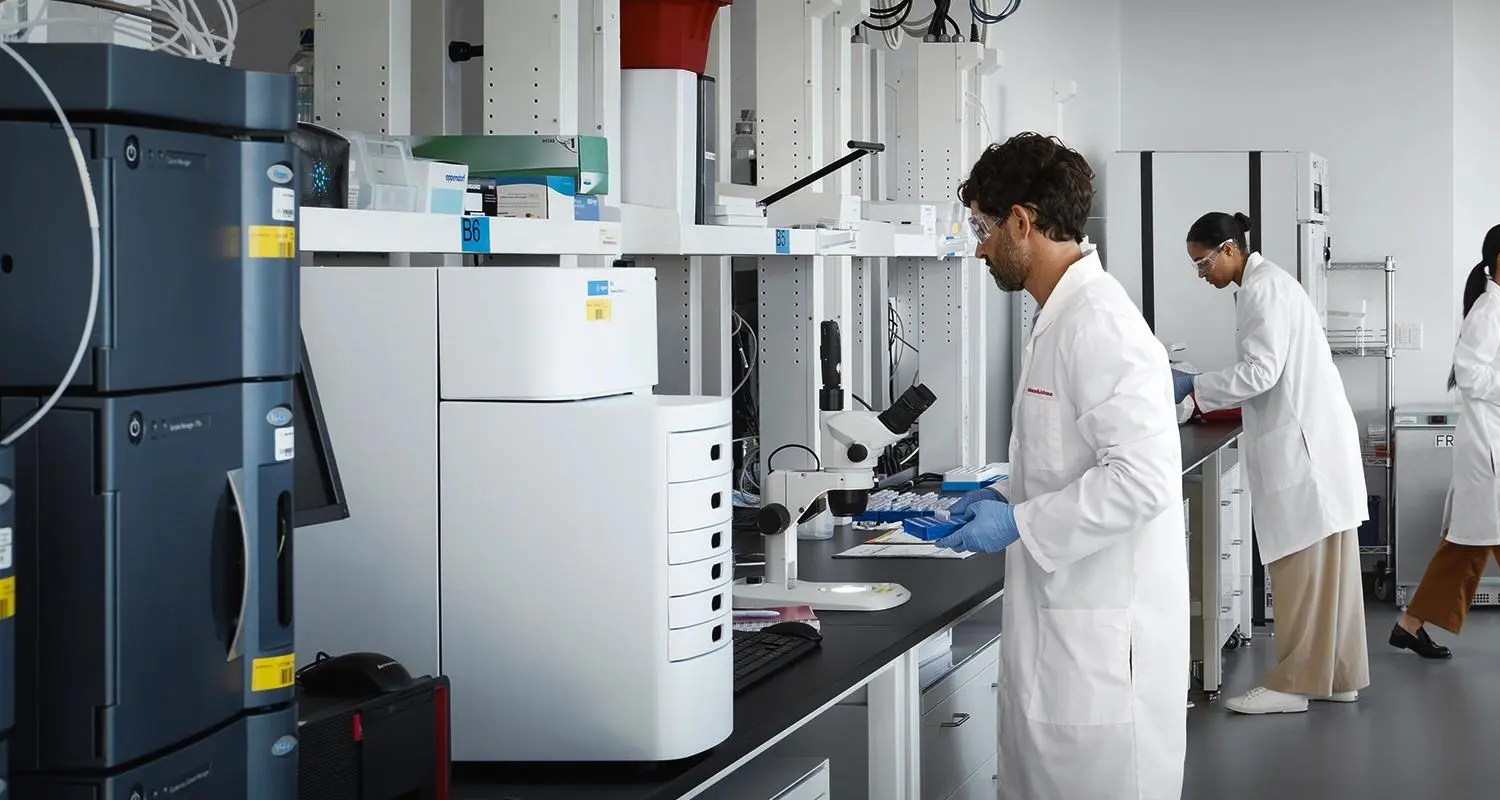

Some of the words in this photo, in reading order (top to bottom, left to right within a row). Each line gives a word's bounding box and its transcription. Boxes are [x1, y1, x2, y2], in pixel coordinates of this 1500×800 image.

[463, 218, 480, 242] B6
[776, 229, 786, 246] B5
[1436, 435, 1454, 446] FR
